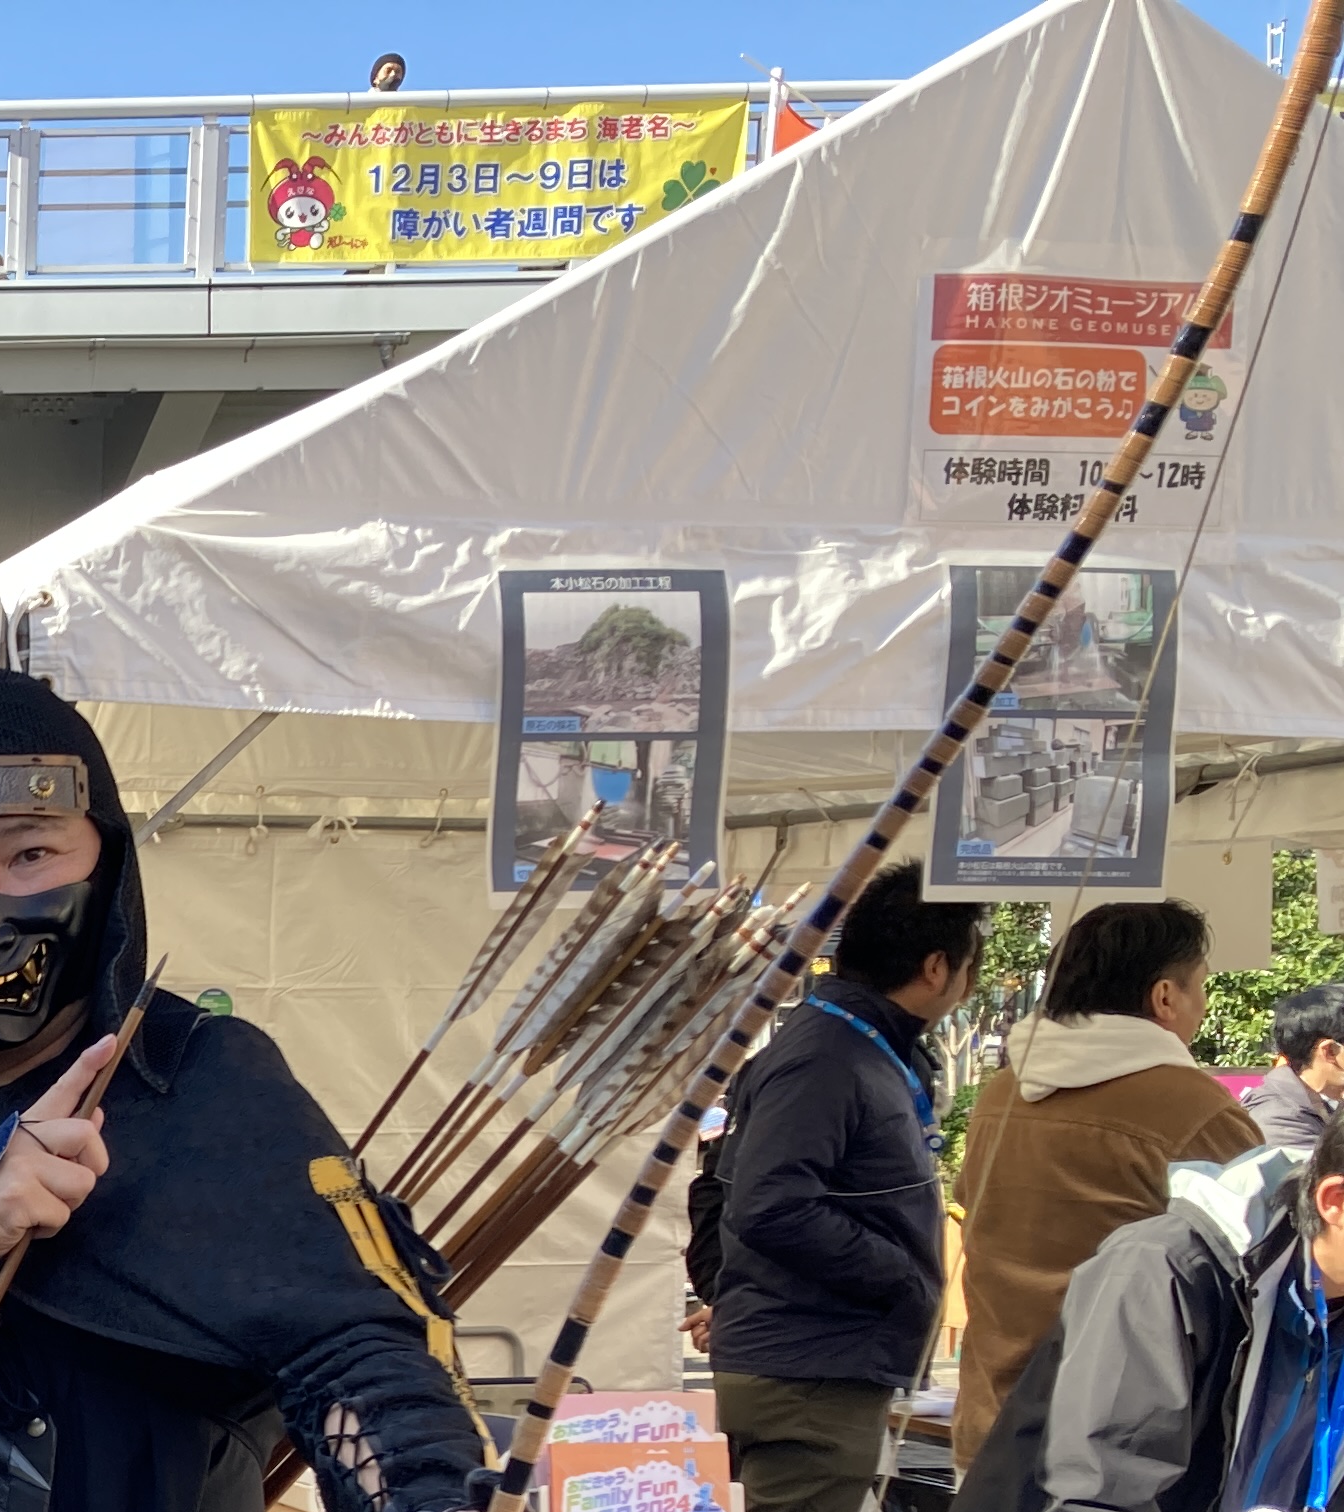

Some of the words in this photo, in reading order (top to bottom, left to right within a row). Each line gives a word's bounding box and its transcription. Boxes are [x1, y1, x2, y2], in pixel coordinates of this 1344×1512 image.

[391, 204, 644, 240] 障がい者週間です
[965, 315, 1059, 331] HAKONE
[1071, 318, 1182, 336] GEOMUSE
[942, 366, 1138, 392] 箱根火山の石の粉で
[944, 457, 1050, 486] 体験時間
[1079, 460, 1206, 489] 10～12時
[1007, 493, 1138, 522] 体験料料
[550, 576, 672, 591] 本小松石の加工工程
[634, 1422, 680, 1442] Fun
[567, 1471, 626, 1494] おだきゅう
[637, 1480, 678, 1501] Fun
